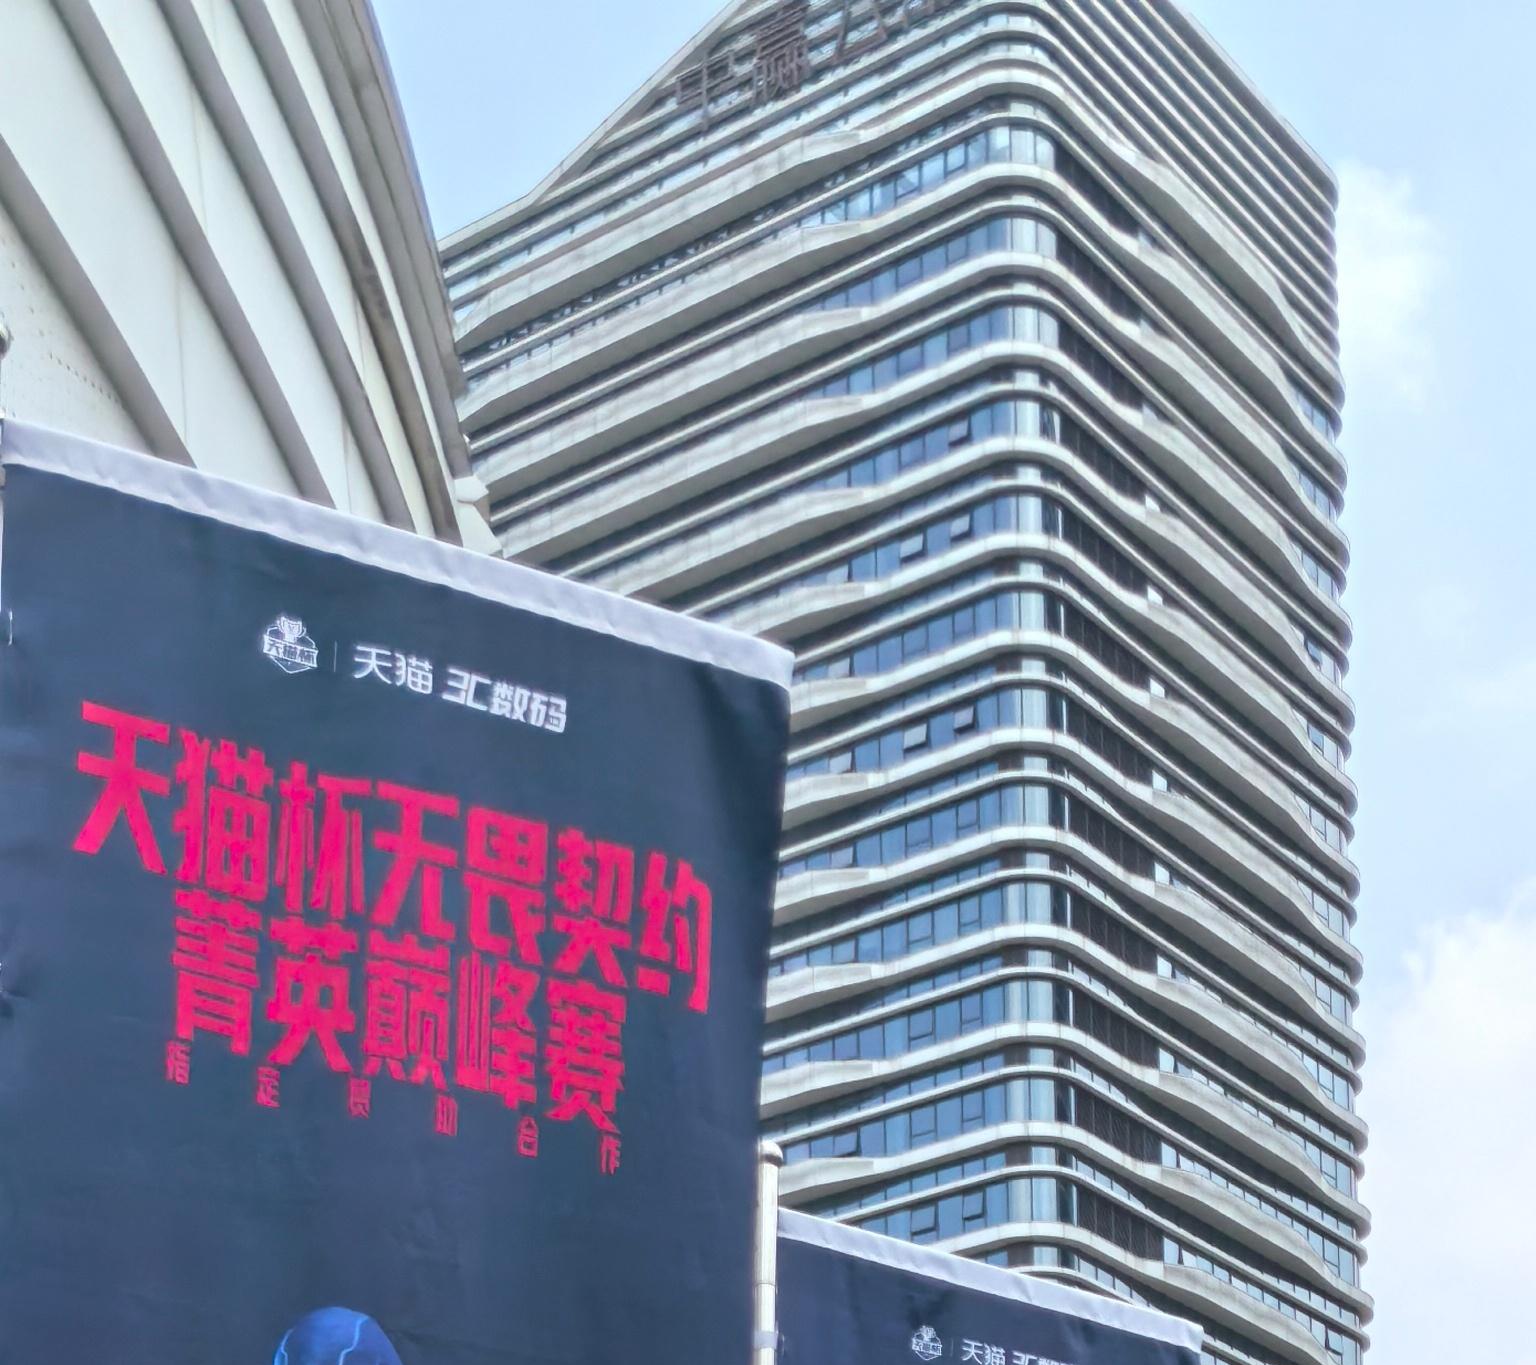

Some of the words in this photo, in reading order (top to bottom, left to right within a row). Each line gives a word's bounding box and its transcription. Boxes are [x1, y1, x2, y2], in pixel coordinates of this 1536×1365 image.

[353, 643, 433, 695] 天猫
[73, 700, 713, 1014] 天猫杯无畏契约
[172, 889, 628, 1134] 菁英巅峰赛
